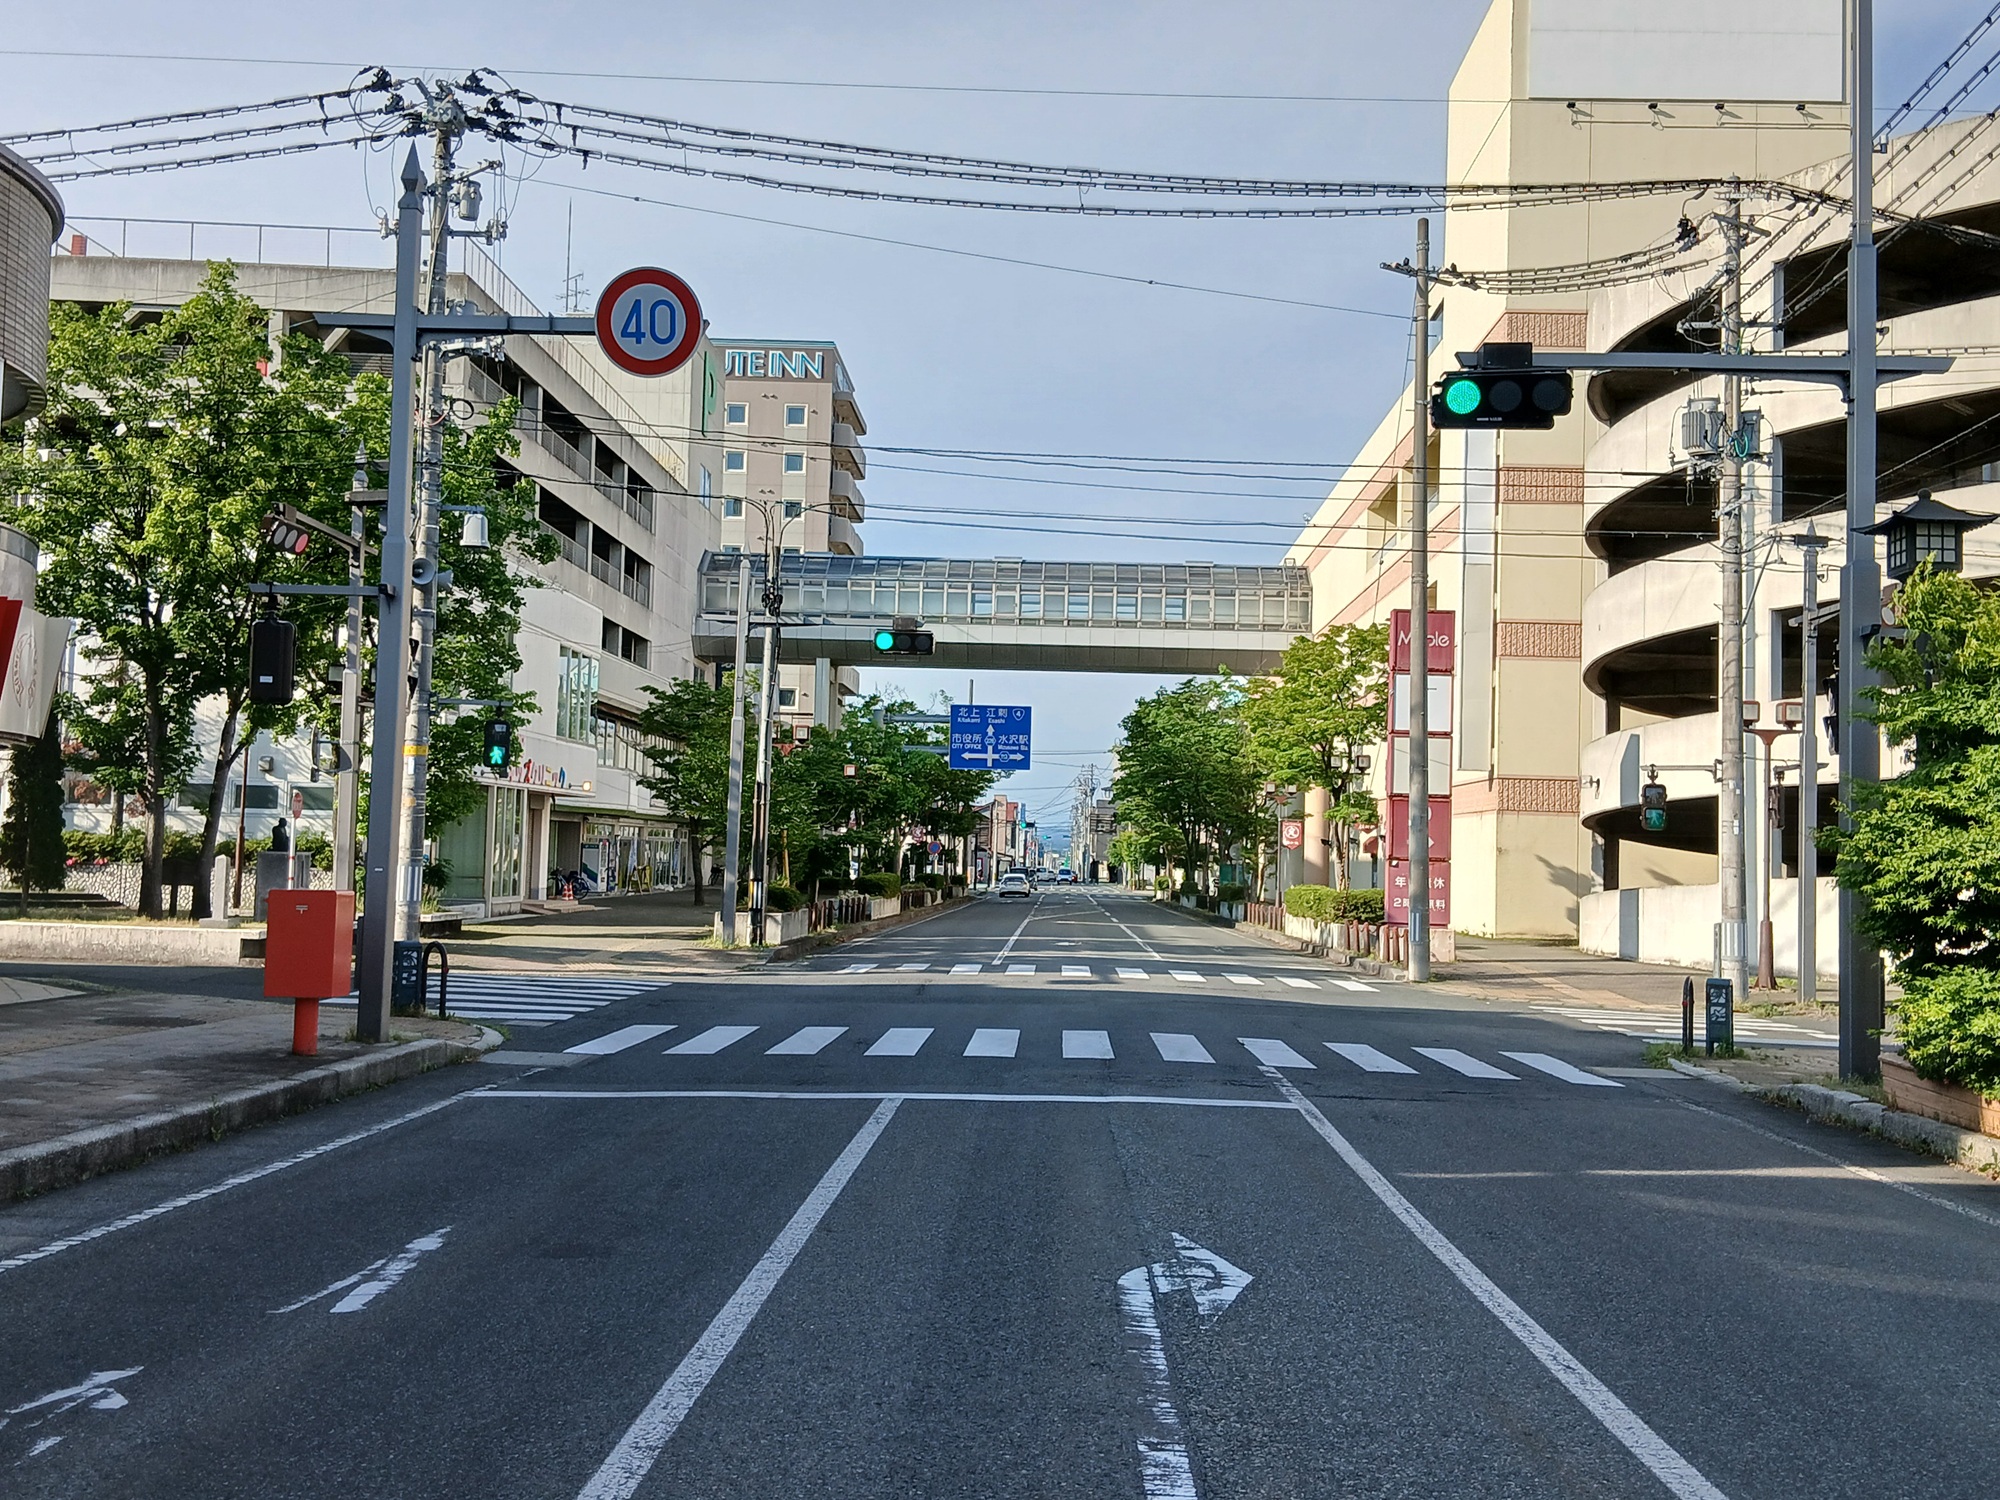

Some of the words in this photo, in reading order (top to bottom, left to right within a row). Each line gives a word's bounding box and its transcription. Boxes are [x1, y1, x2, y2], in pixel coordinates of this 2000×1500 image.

[620, 298, 677, 345] 40
[768, 350, 823, 379] INN
[1397, 630, 1450, 647] Mle
[958, 707, 980, 717] 北上
[952, 733, 982, 743] 市役所
[998, 734, 1029, 745] 水沢駅
[1394, 876, 1445, 889] 年休
